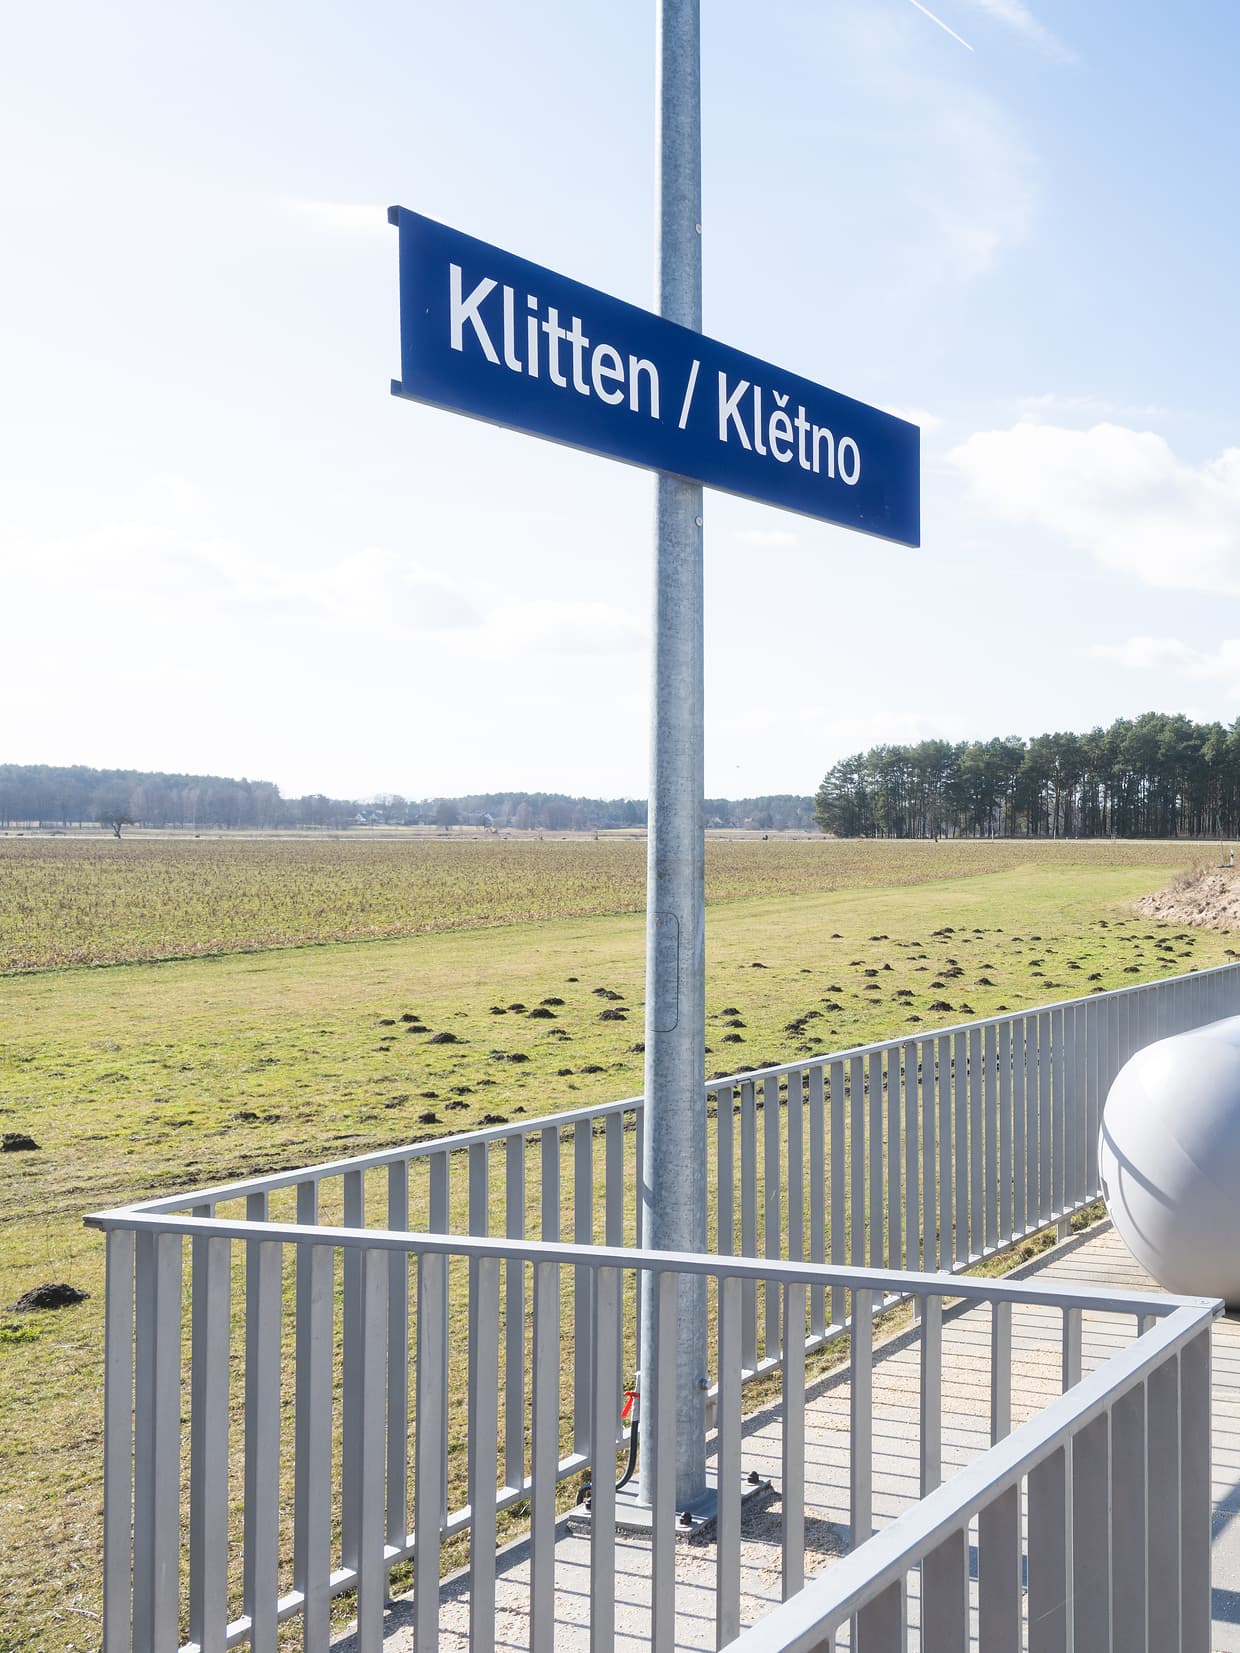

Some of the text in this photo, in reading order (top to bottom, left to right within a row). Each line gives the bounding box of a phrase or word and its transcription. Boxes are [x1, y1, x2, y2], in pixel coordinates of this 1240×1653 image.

[450, 263, 861, 486] Klitten / Klětno
